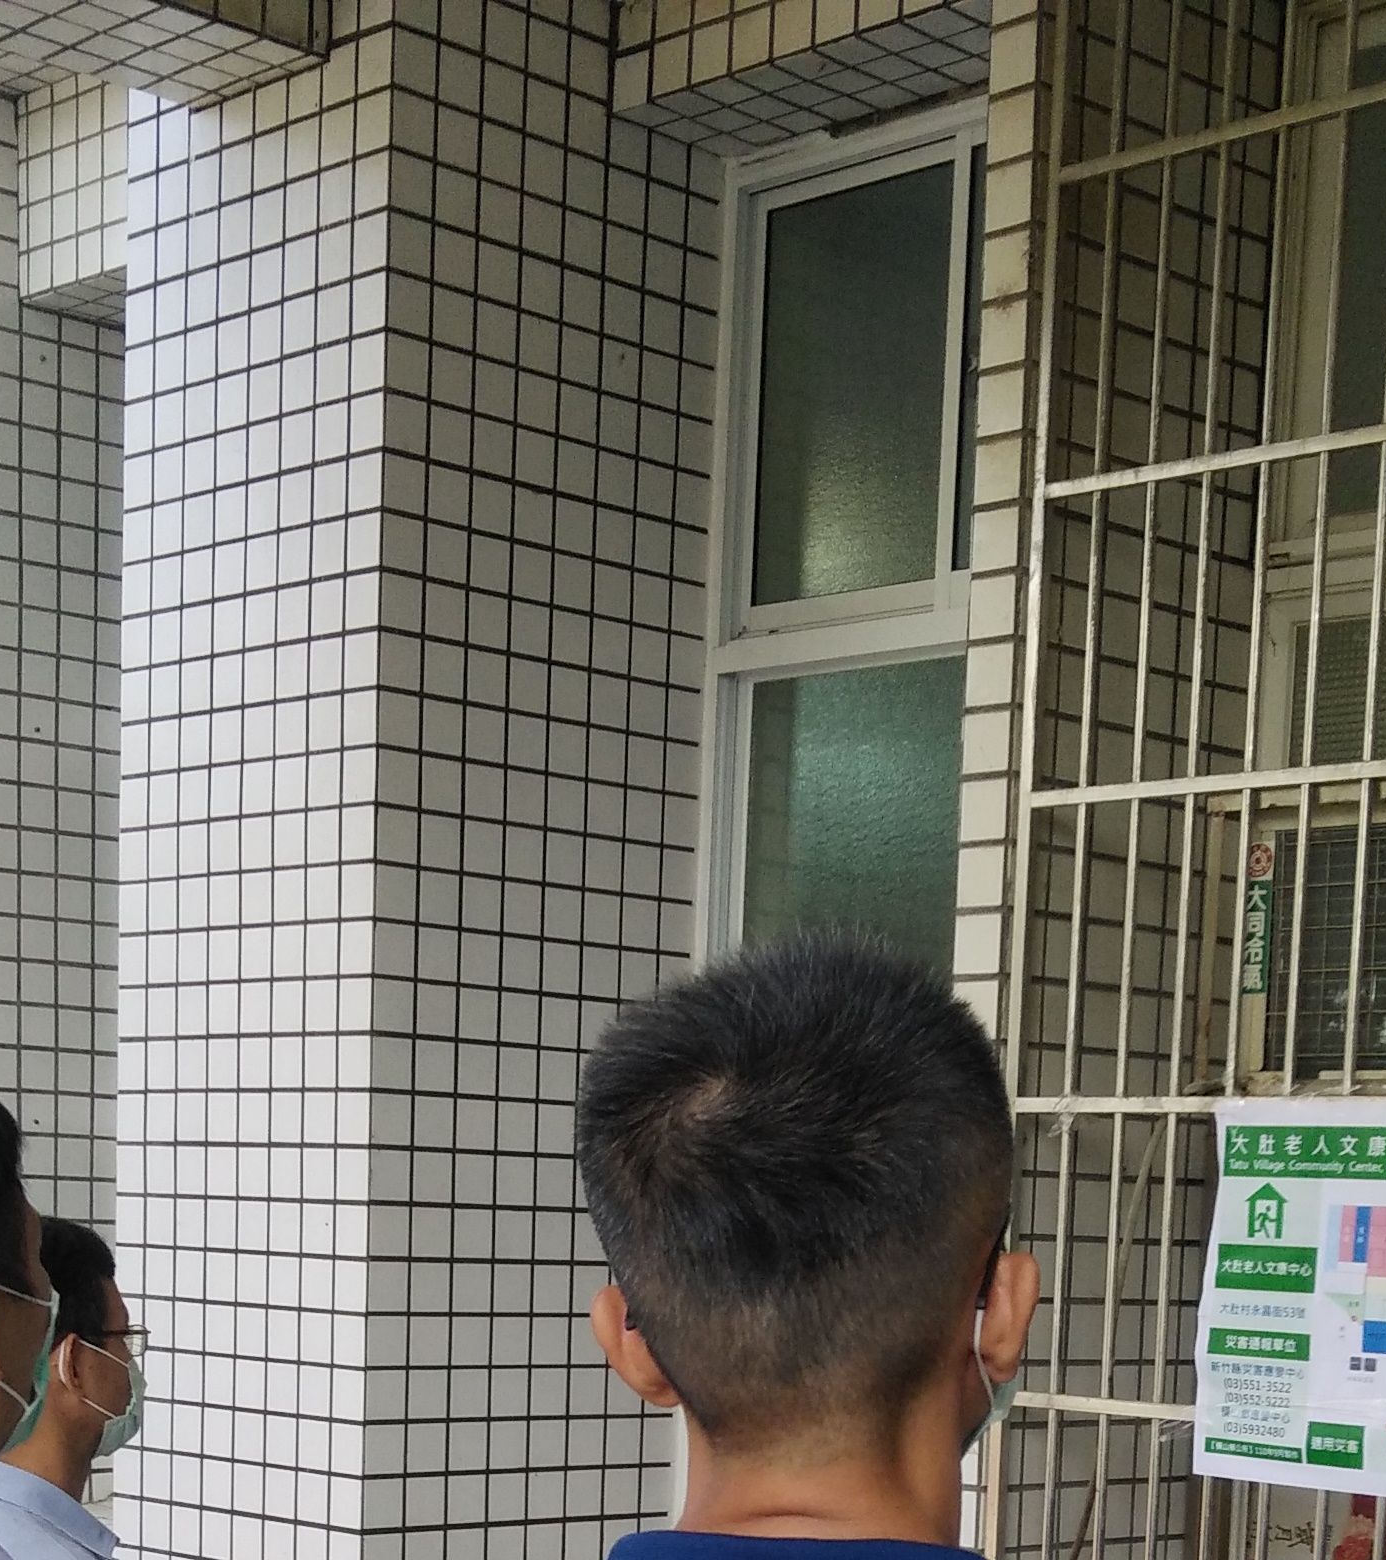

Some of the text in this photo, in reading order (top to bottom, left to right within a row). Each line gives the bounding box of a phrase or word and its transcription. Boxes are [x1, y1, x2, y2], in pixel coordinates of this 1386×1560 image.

[1253, 1159, 1286, 1173] Village
[1288, 1159, 1345, 1174] Community
[1220, 1258, 1313, 1277] 大肚老人文康中心
[1223, 1377, 1292, 1394] (03)551-3522
[1223, 1421, 1286, 1438] (03)5932480
